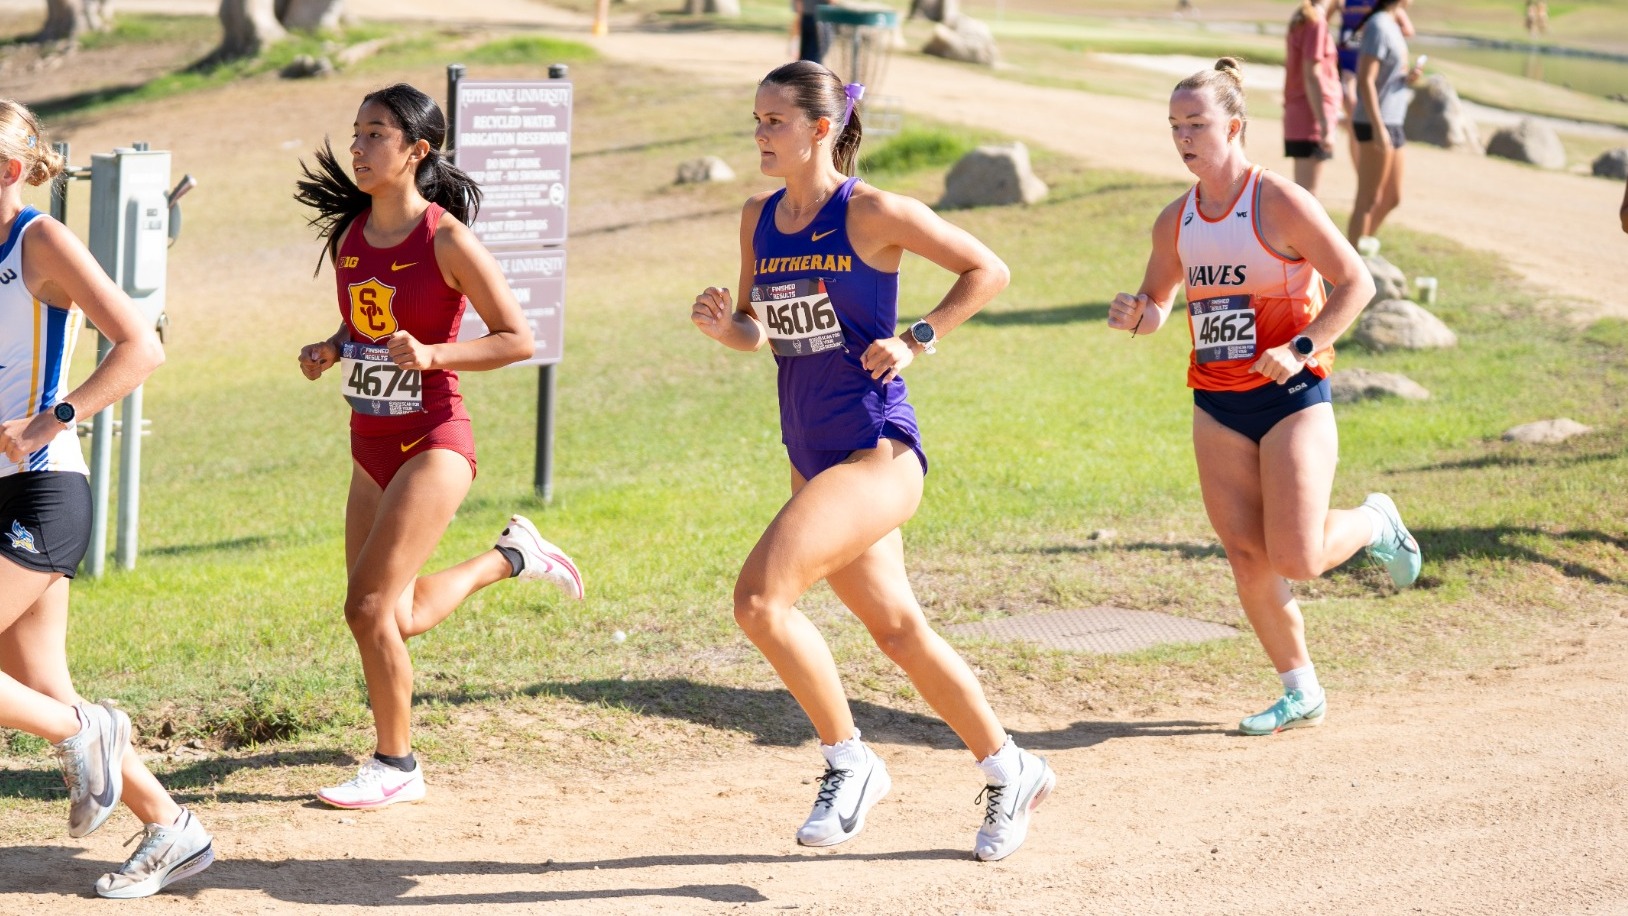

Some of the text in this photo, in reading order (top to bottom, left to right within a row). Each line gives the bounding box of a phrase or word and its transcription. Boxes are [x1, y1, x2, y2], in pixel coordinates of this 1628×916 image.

[516, 88, 569, 106] UNIVERSITY
[473, 114, 556, 129] RECYCLED WATER
[460, 131, 568, 147] IRRIGATION RESERVOIR
[760, 255, 852, 274] LUTHERAN
[771, 283, 796, 293] FINISHED
[772, 290, 796, 299] RESULTS
[766, 297, 836, 336] 4606
[1199, 312, 1255, 345] 4662
[348, 362, 422, 398] 4674
